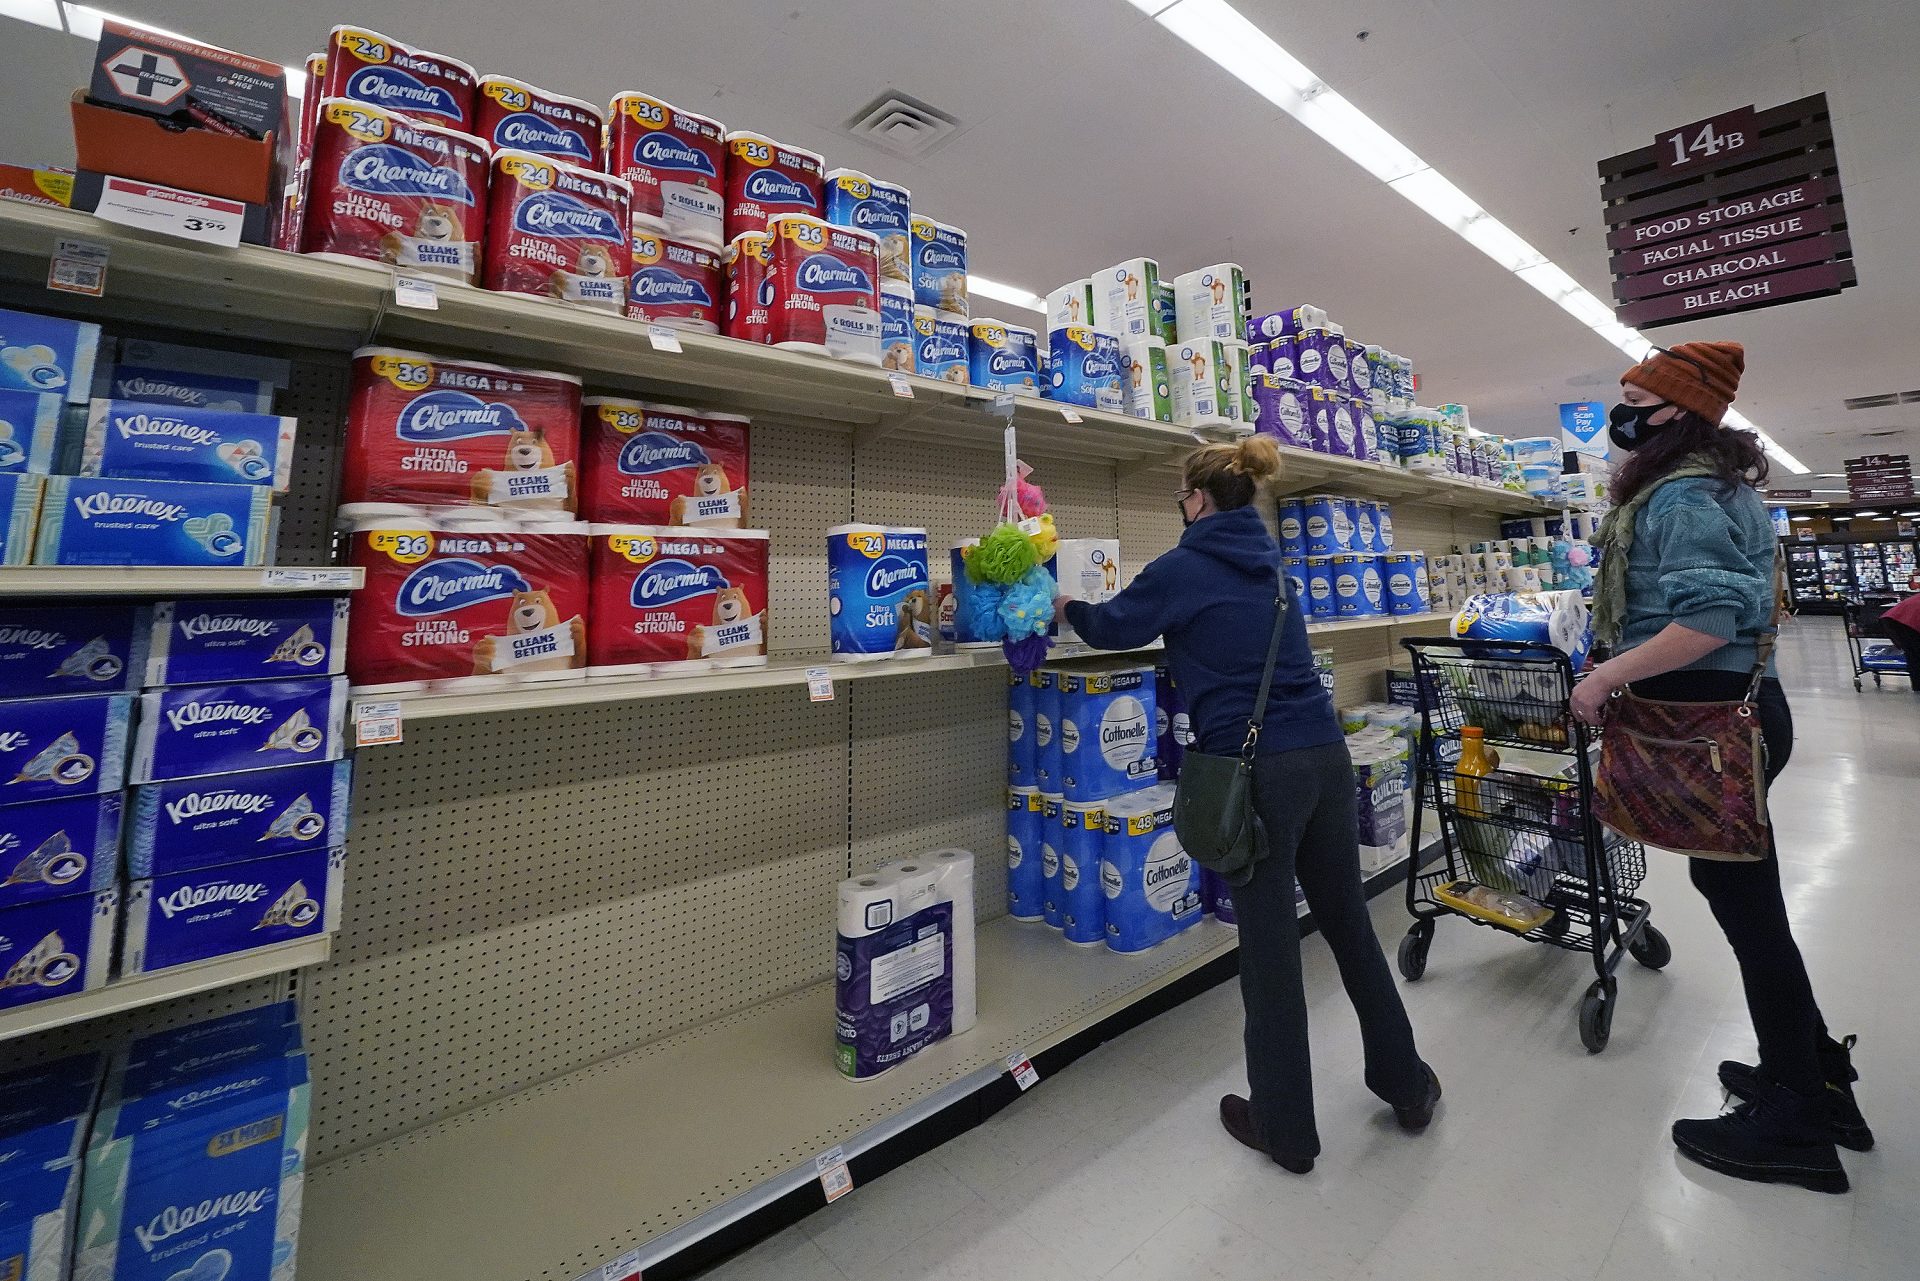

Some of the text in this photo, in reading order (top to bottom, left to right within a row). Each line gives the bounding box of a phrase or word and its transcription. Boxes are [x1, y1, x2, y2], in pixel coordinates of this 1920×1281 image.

[356, 37, 386, 60] 24
[392, 54, 441, 77] MEGA
[138, 71, 175, 85] ERASERS
[231, 72, 275, 90] DETAILING
[358, 75, 441, 106] Charmin
[502, 87, 527, 108] 24
[532, 101, 573, 121] MEGA
[638, 101, 663, 123] 36
[349, 111, 385, 136] 24
[673, 114, 700, 127] SUPER
[675, 122, 699, 135] MEGA
[394, 128, 449, 154] MEGA
[504, 121, 572, 149] Charmin
[642, 141, 700, 166] Charmin
[746, 143, 768, 160] 36
[777, 151, 802, 164] SUPER
[779, 158, 801, 169] MEGA
[354, 155, 449, 190] Charmin
[520, 163, 550, 187] 24
[620, 172, 658, 186] STRONG
[627, 166, 652, 178] ULTRA
[556, 174, 603, 199] MEGA
[751, 177, 802, 199] Charmin
[347, 192, 392, 214] ULTRA
[680, 195, 705, 210] ROLLS
[706, 202, 715, 210] IN
[872, 189, 898, 203] MEGA
[733, 207, 766, 219] STRONG
[738, 202, 761, 211] ULTRA
[1635, 187, 1804, 241] FOOD STORAGE
[333, 202, 404, 229] STRONG
[525, 204, 602, 232] Charmin
[857, 207, 900, 227] Charmin
[798, 224, 822, 244] 36
[831, 232, 857, 246] SUPER
[936, 231, 957, 244] MEGA
[1642, 217, 1803, 265] FACIAL TISSUE
[418, 244, 459, 257] CLEANS
[521, 237, 557, 255] ULTRA
[833, 241, 857, 252] MEGA
[418, 253, 460, 265] BETTER
[509, 245, 568, 267] STRONG
[669, 253, 693, 264] MEGA
[924, 249, 959, 266] Charmin
[805, 262, 858, 284] Charmin
[1662, 251, 1786, 287] CHARCOAL
[579, 280, 613, 291] CLEANS
[580, 288, 614, 299] BETTER
[635, 276, 694, 297] Charmin
[790, 293, 814, 303] ULTRA
[1683, 281, 1771, 310] BLEACH
[784, 300, 821, 312] STRONG
[840, 318, 865, 331] ROLLS
[923, 343, 960, 359] Charmin
[993, 355, 1025, 371] Charmin
[398, 363, 428, 382] 36
[439, 370, 491, 391] MEGA
[117, 377, 207, 405] Kleenex
[410, 403, 502, 432] Charmin
[616, 411, 639, 426] 36
[646, 418, 684, 431] MEGA
[1576, 419, 1592, 427] Pay
[115, 414, 218, 446] Kleenex
[414, 447, 456, 460] ULTRA
[627, 443, 692, 466] Charmin
[401, 456, 468, 474] STRONG
[507, 475, 549, 487] CLEANS
[630, 479, 660, 489] ULTRA
[509, 484, 551, 496] BETTER
[621, 487, 669, 500] STRONG
[74, 491, 184, 523] Kleenex
[697, 498, 728, 510] CLEANS
[699, 505, 729, 516] BETTER
[395, 535, 427, 555] 36
[438, 538, 492, 554] MEGA
[629, 540, 653, 556] 36
[661, 543, 700, 555] MEGA
[864, 536, 883, 552] 24
[887, 539, 915, 551] MEGA
[642, 568, 709, 597] Charmin
[871, 563, 918, 589] Charmin
[410, 573, 503, 605] Charmin
[644, 612, 676, 623] ULTRA
[870, 604, 890, 615] Ultra
[179, 613, 275, 641] Kleenex
[415, 620, 457, 633] ULTRA
[634, 620, 686, 633] STRONG
[865, 612, 895, 628] Soft
[401, 630, 470, 646] STRONG
[716, 623, 750, 638] CLEANS
[718, 631, 751, 645] BETTER
[512, 632, 555, 652] CLEANS
[514, 642, 557, 658] BETTER
[1094, 676, 1131, 690] 48 MEGA
[166, 701, 269, 731] Kleenex
[1103, 722, 1146, 743] Cottonelle
[1371, 779, 1403, 806] QUILTED
[165, 793, 270, 824] Kleenex
[193, 817, 240, 831] ultra soft
[1137, 814, 1152, 830] 48
[1146, 859, 1189, 887] Cottonelle
[158, 883, 265, 919] Kleenex
[186, 908, 235, 924] ultra soft
[135, 1187, 268, 1253] Kleenex
[151, 1220, 247, 1262] trusted care
